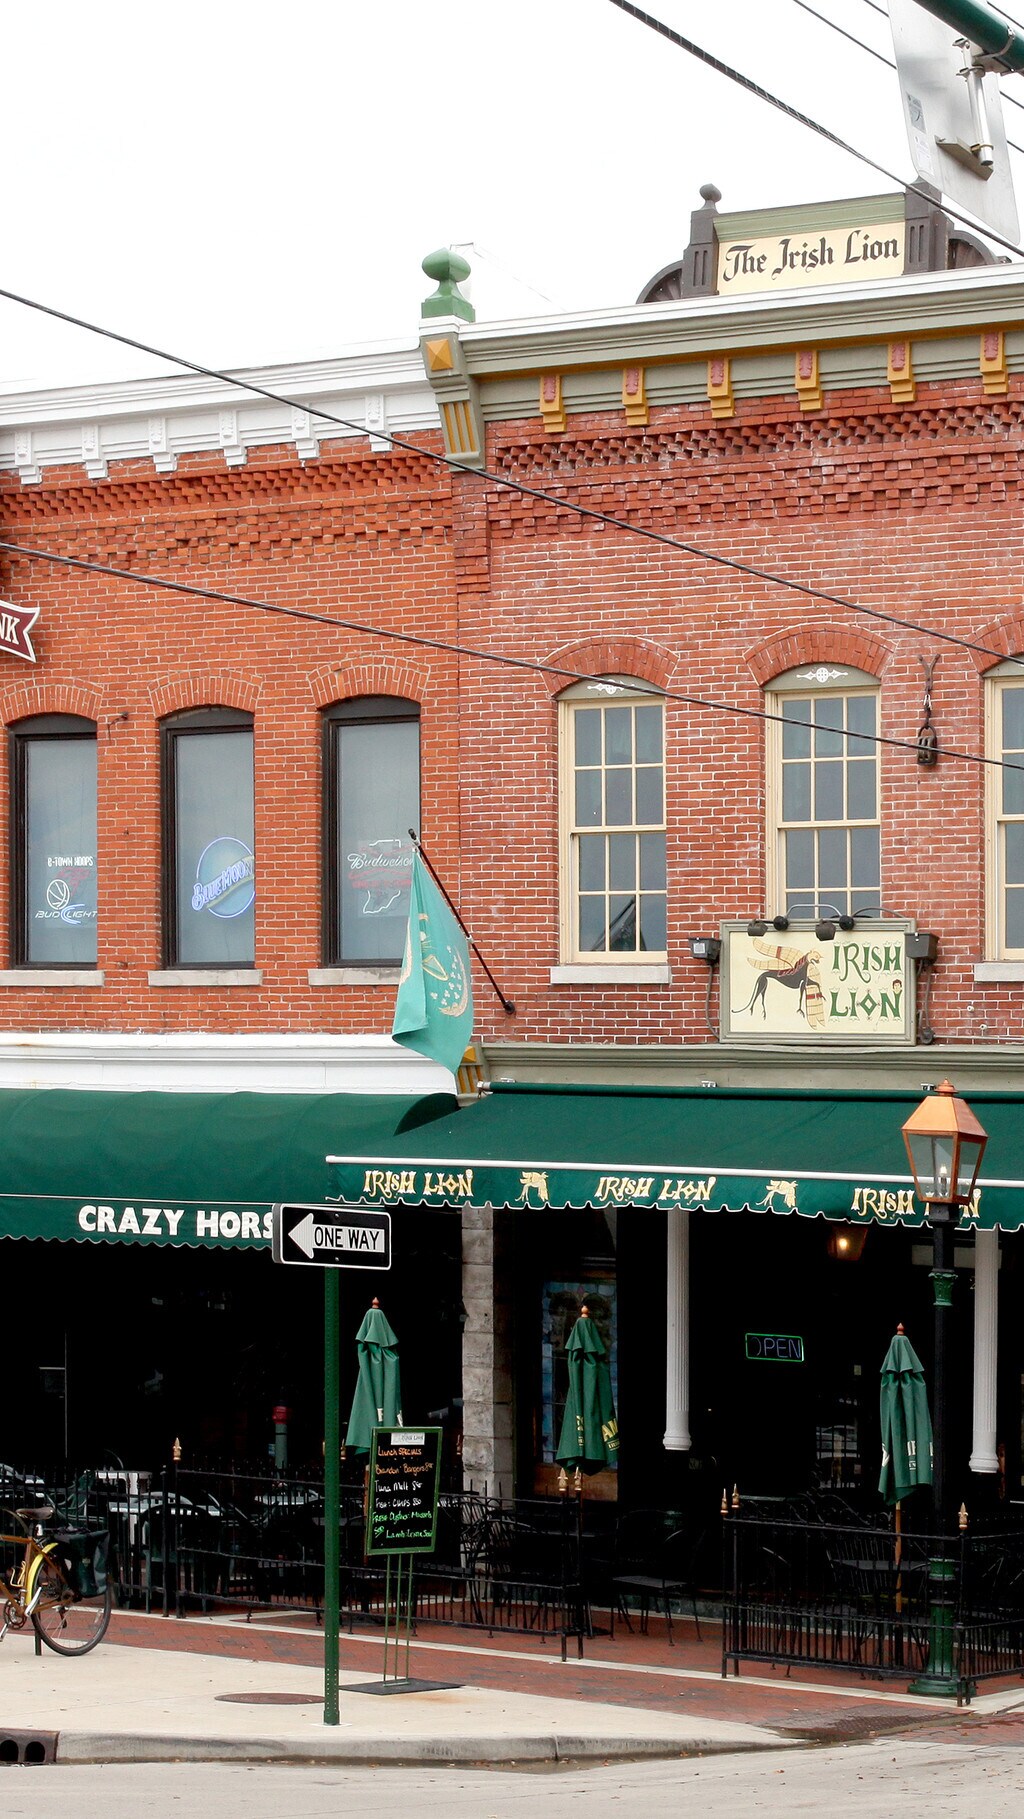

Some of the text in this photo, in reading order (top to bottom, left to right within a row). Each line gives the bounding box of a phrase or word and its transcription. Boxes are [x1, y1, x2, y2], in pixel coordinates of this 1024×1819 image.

[722, 229, 900, 281] The Irish Lion
[35, 910, 60, 919] BUD
[831, 941, 904, 984] IRISH
[829, 985, 903, 1023] LION
[363, 1169, 475, 1200] IRISH LION
[594, 1175, 717, 1202] IRISH LION
[851, 1187, 916, 1219] IRISH
[78, 1205, 185, 1236] CRAZY
[314, 1226, 380, 1251] ONE WAY
